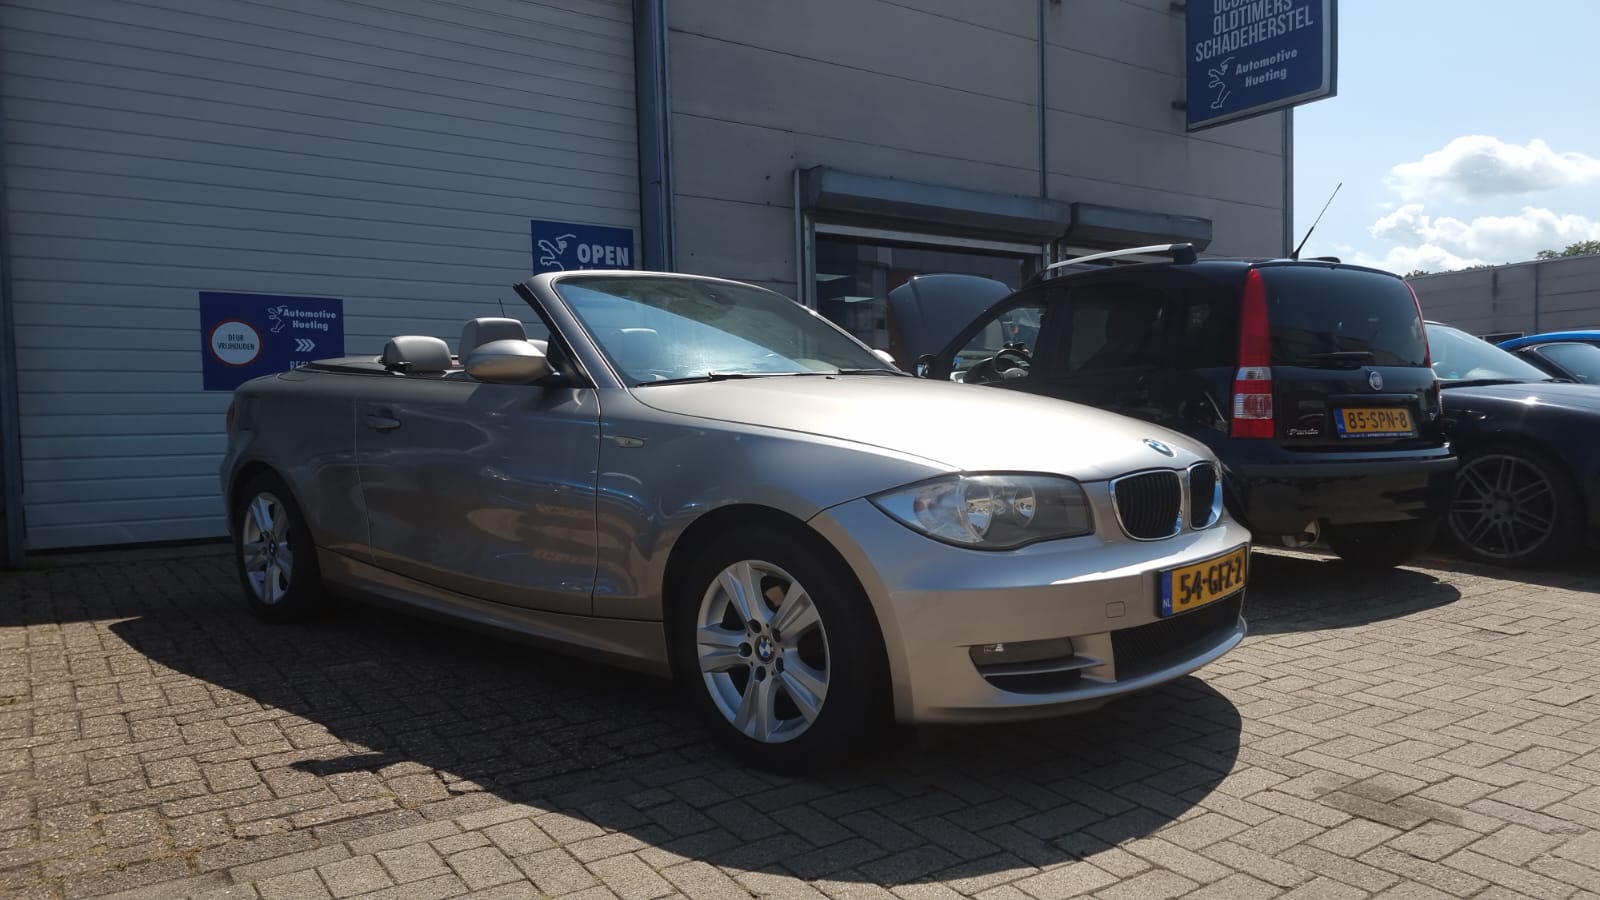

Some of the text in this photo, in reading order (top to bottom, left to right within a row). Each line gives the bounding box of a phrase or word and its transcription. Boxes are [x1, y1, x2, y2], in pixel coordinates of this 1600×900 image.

[1213, 0, 1292, 36] OLDTIMERS
[1195, 5, 1314, 62] SCHADEHERSTEL
[1235, 48, 1298, 75] Automotive
[1245, 68, 1287, 88] Hueting
[577, 243, 629, 266] OPEN
[283, 308, 337, 319] Automotive
[293, 320, 329, 332] Hueting
[228, 334, 244, 342] DEUR
[1348, 411, 1408, 429] 85-SPN-8
[1180, 556, 1242, 604] 54-GFZ-2
[1163, 599, 1171, 609] NL
